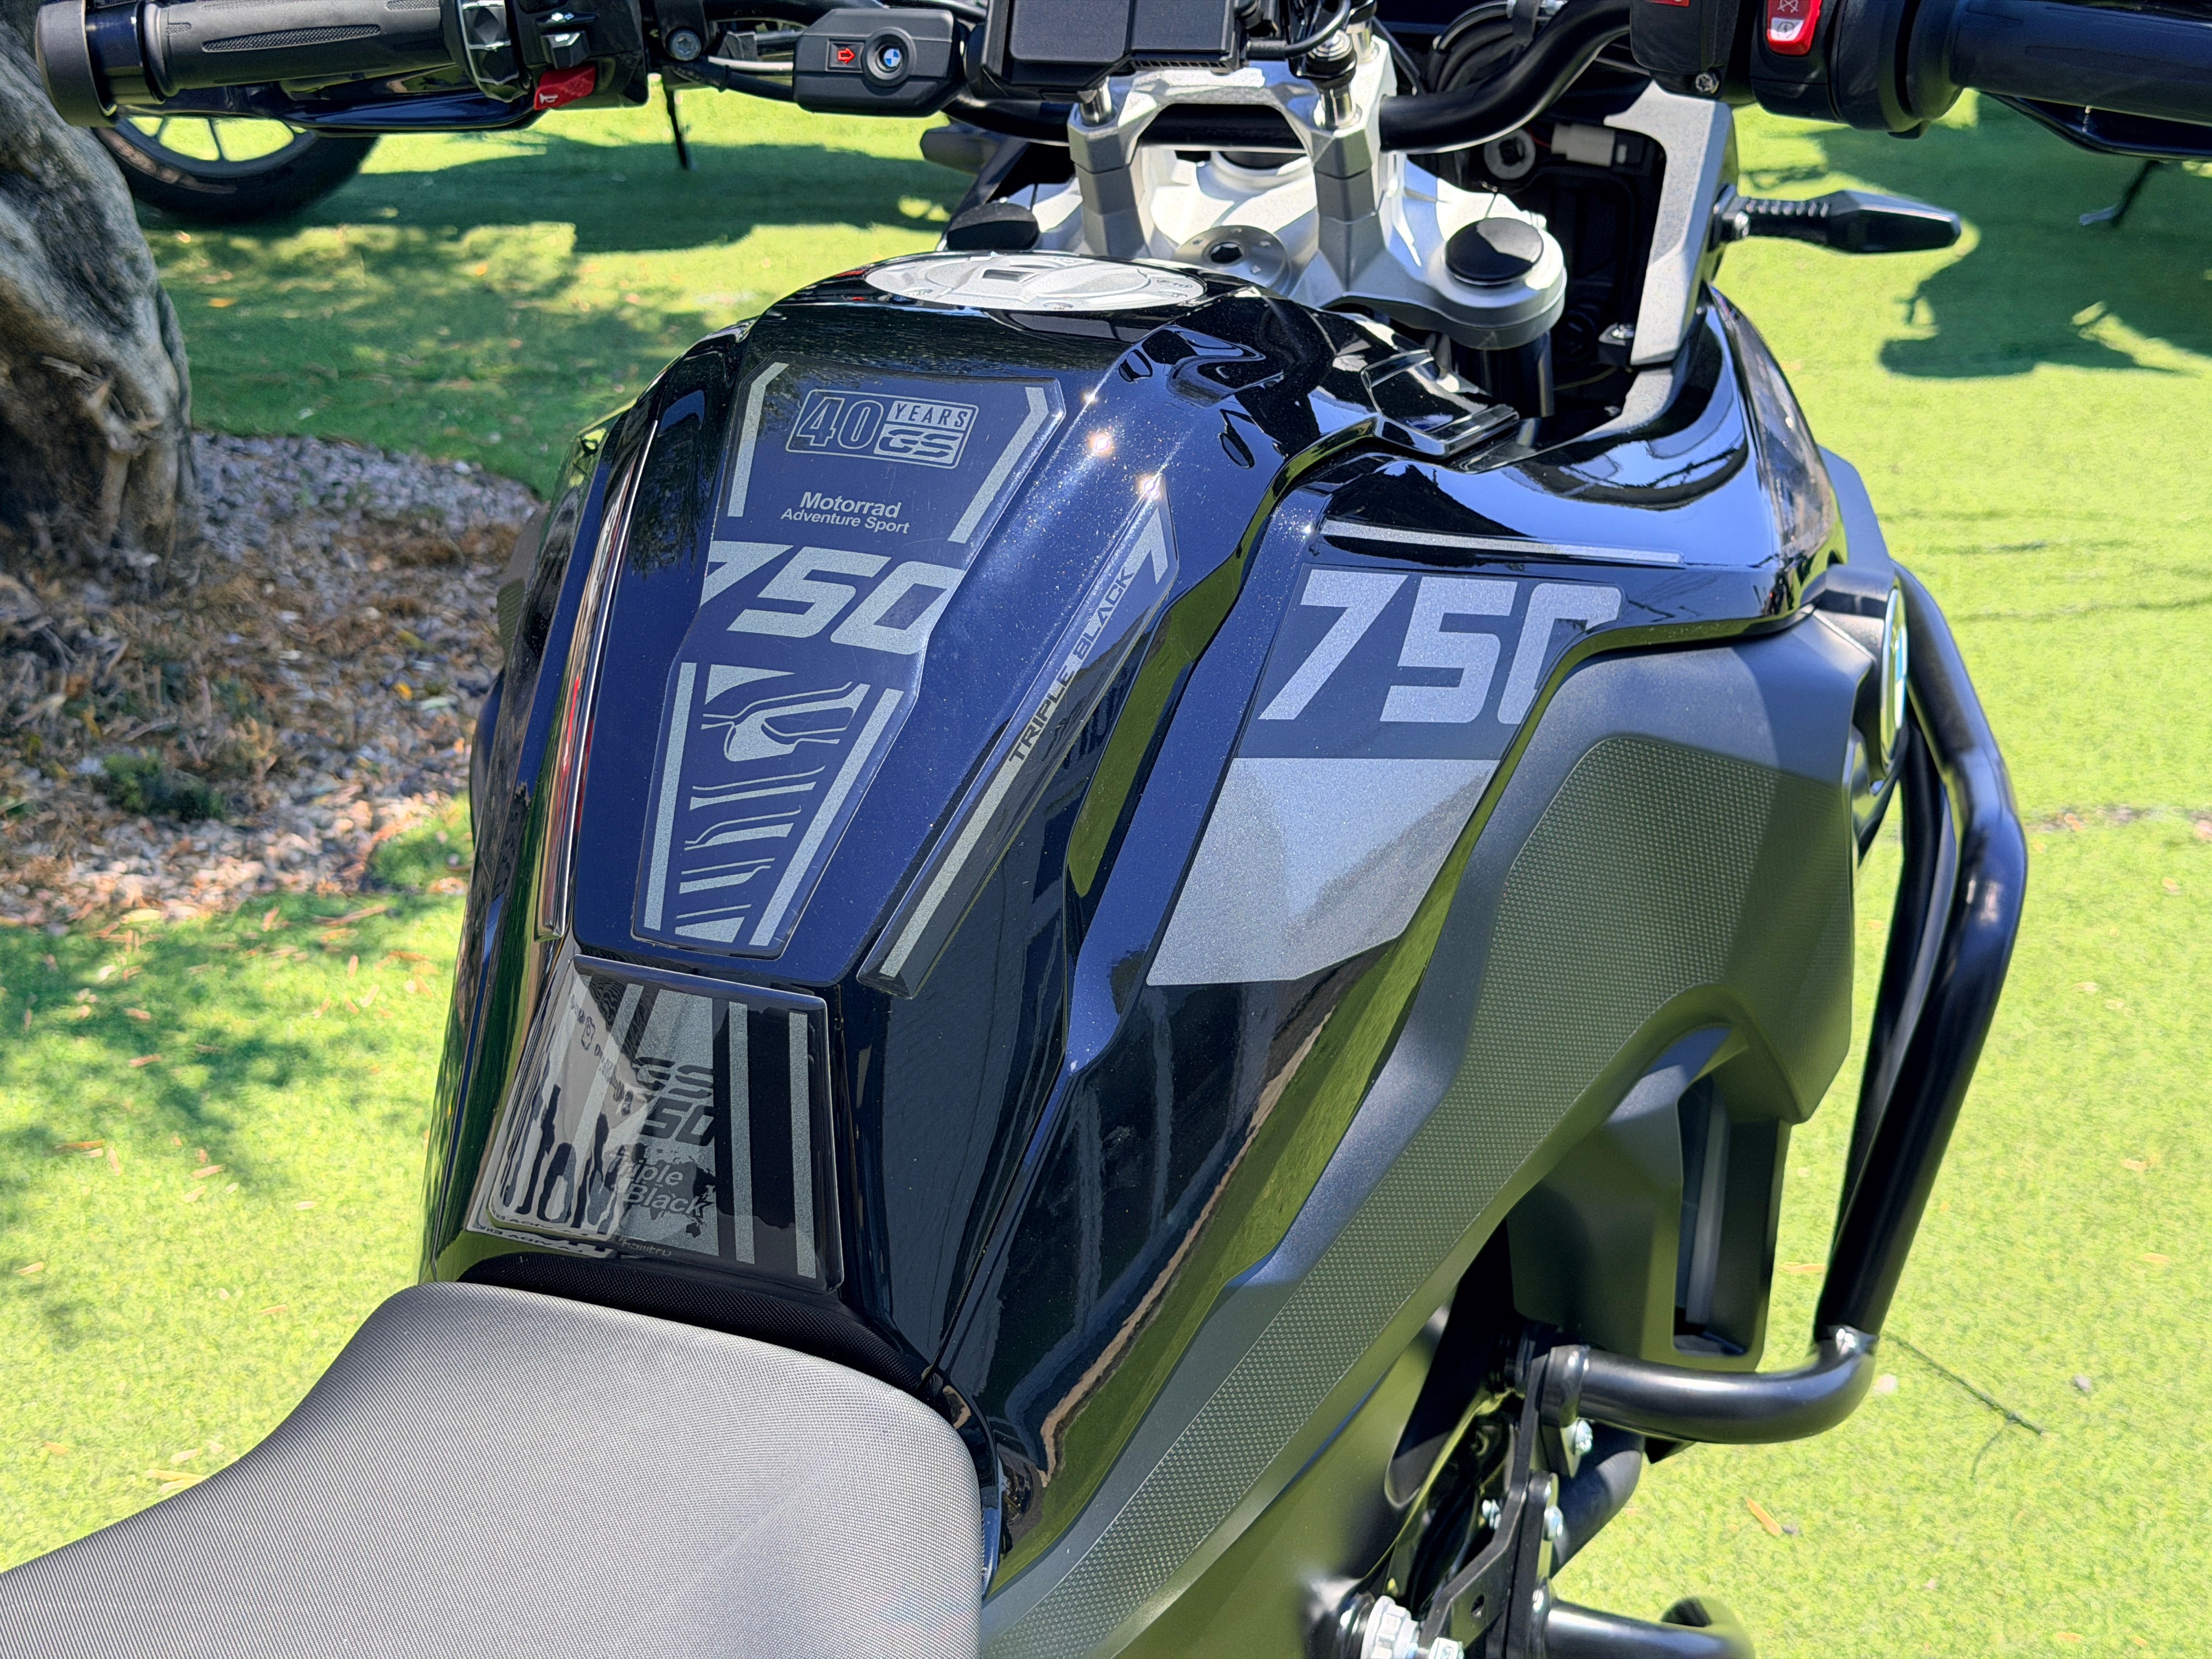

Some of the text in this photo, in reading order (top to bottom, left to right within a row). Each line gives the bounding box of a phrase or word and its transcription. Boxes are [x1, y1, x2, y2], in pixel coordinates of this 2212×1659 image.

[796, 397, 884, 449] 40
[893, 403, 968, 426] YEARS
[878, 428, 961, 458] GS
[781, 508, 910, 534] Adventure Sport
[799, 492, 901, 518] Motorrad
[701, 540, 966, 654] 750
[1008, 567, 1135, 763] TRIPLE BLACK
[624, 1182, 712, 1217] Black
